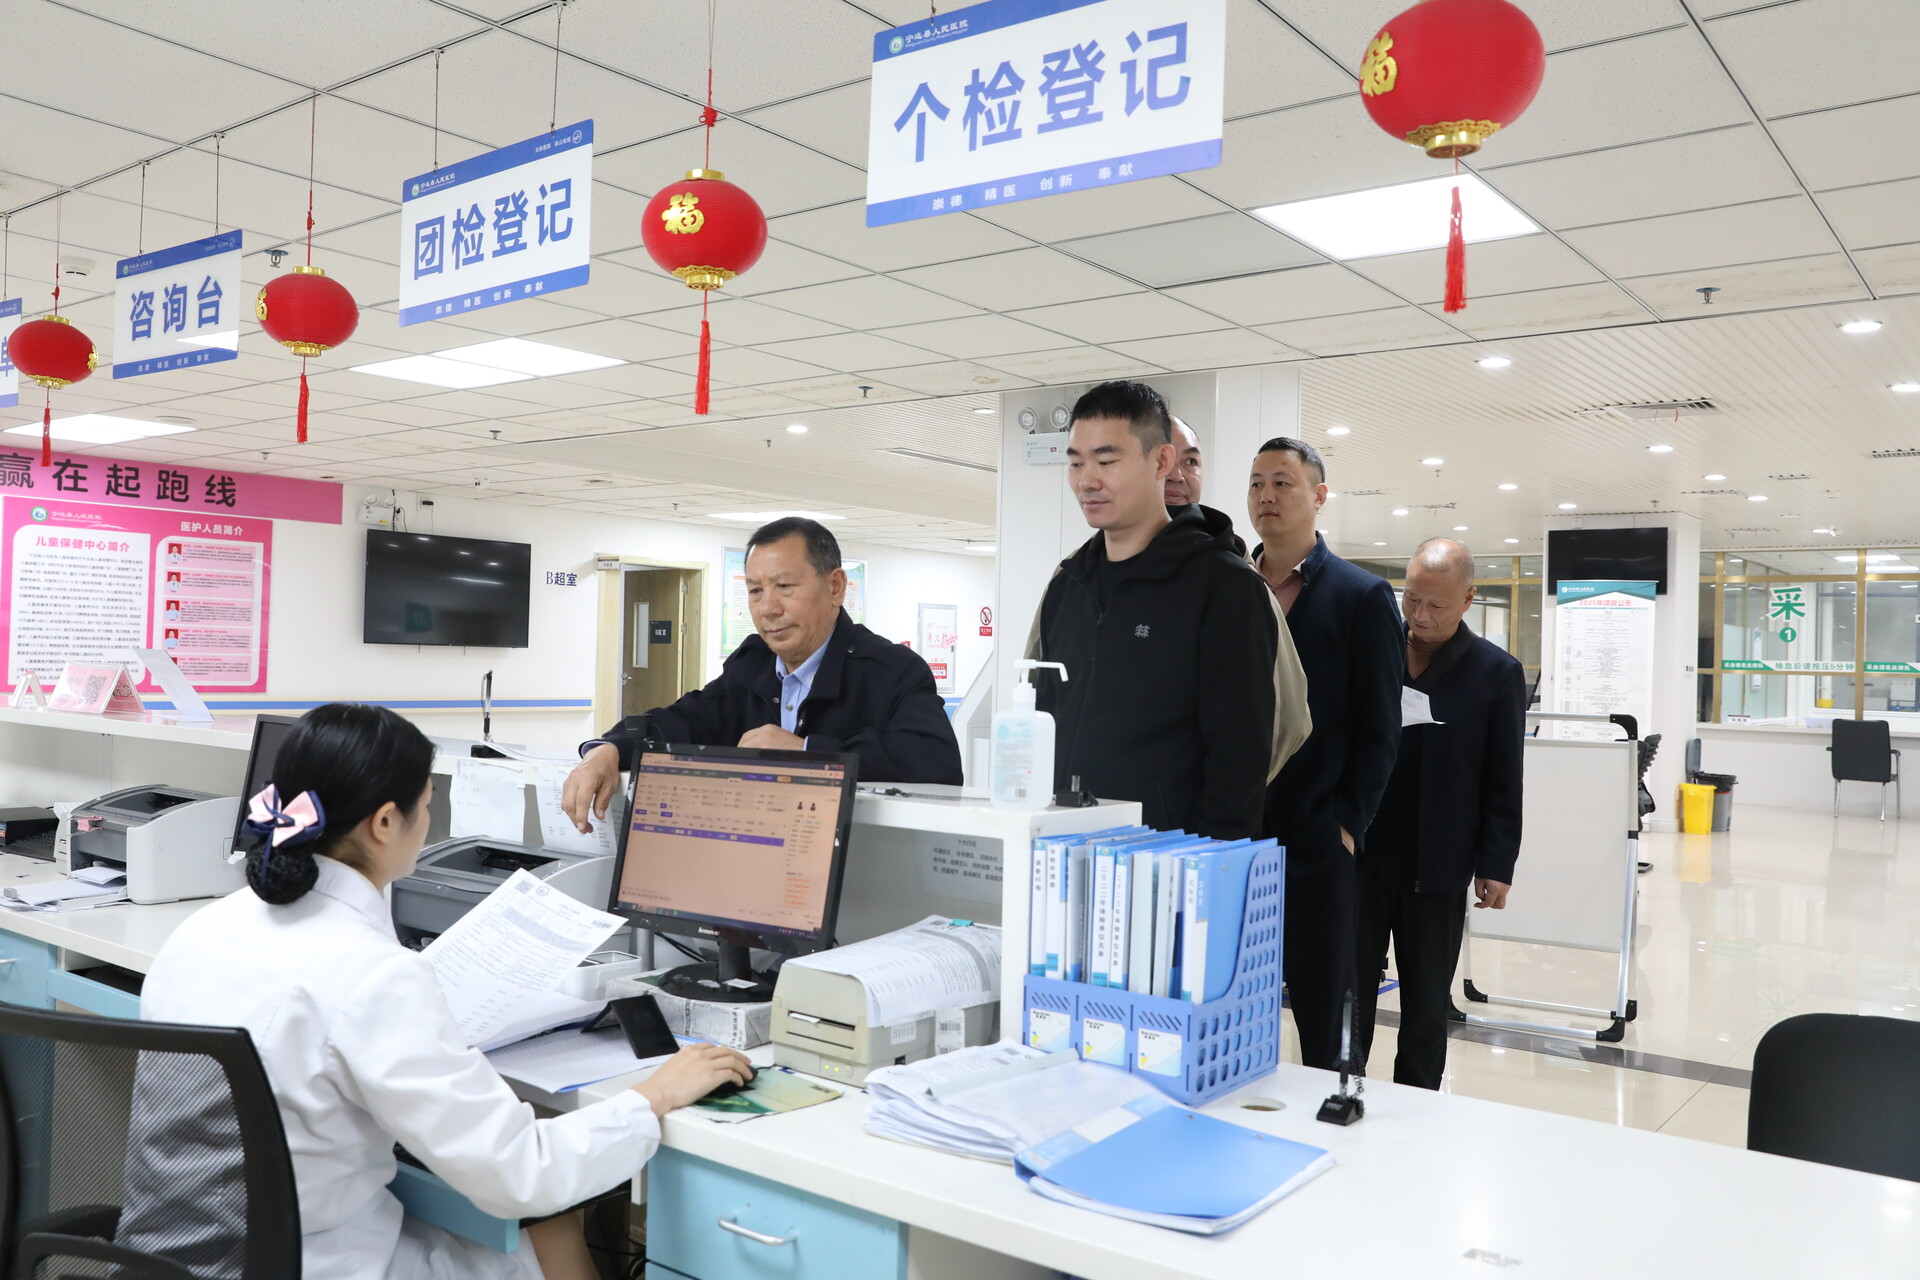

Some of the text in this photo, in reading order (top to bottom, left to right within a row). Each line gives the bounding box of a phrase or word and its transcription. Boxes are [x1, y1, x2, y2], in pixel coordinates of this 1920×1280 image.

[905, 19, 969, 43] 宁远县人民医院
[894, 21, 1192, 163] 个检登记
[932, 162, 1133, 211] 崇德 精医 创新 奉献
[414, 178, 573, 280] 团检登记
[661, 192, 705, 234] 福
[130, 275, 223, 341] 咨询台
[0, 453, 237, 507] 赢在起跑线
[35, 536, 130, 552] 儿童保健中心简介
[180, 521, 243, 536] 医护人员简介
[546, 571, 577, 586] B超室
[1770, 587, 1806, 621] 采
[1775, 662, 1854, 671] 抽血后请按压5分钟
